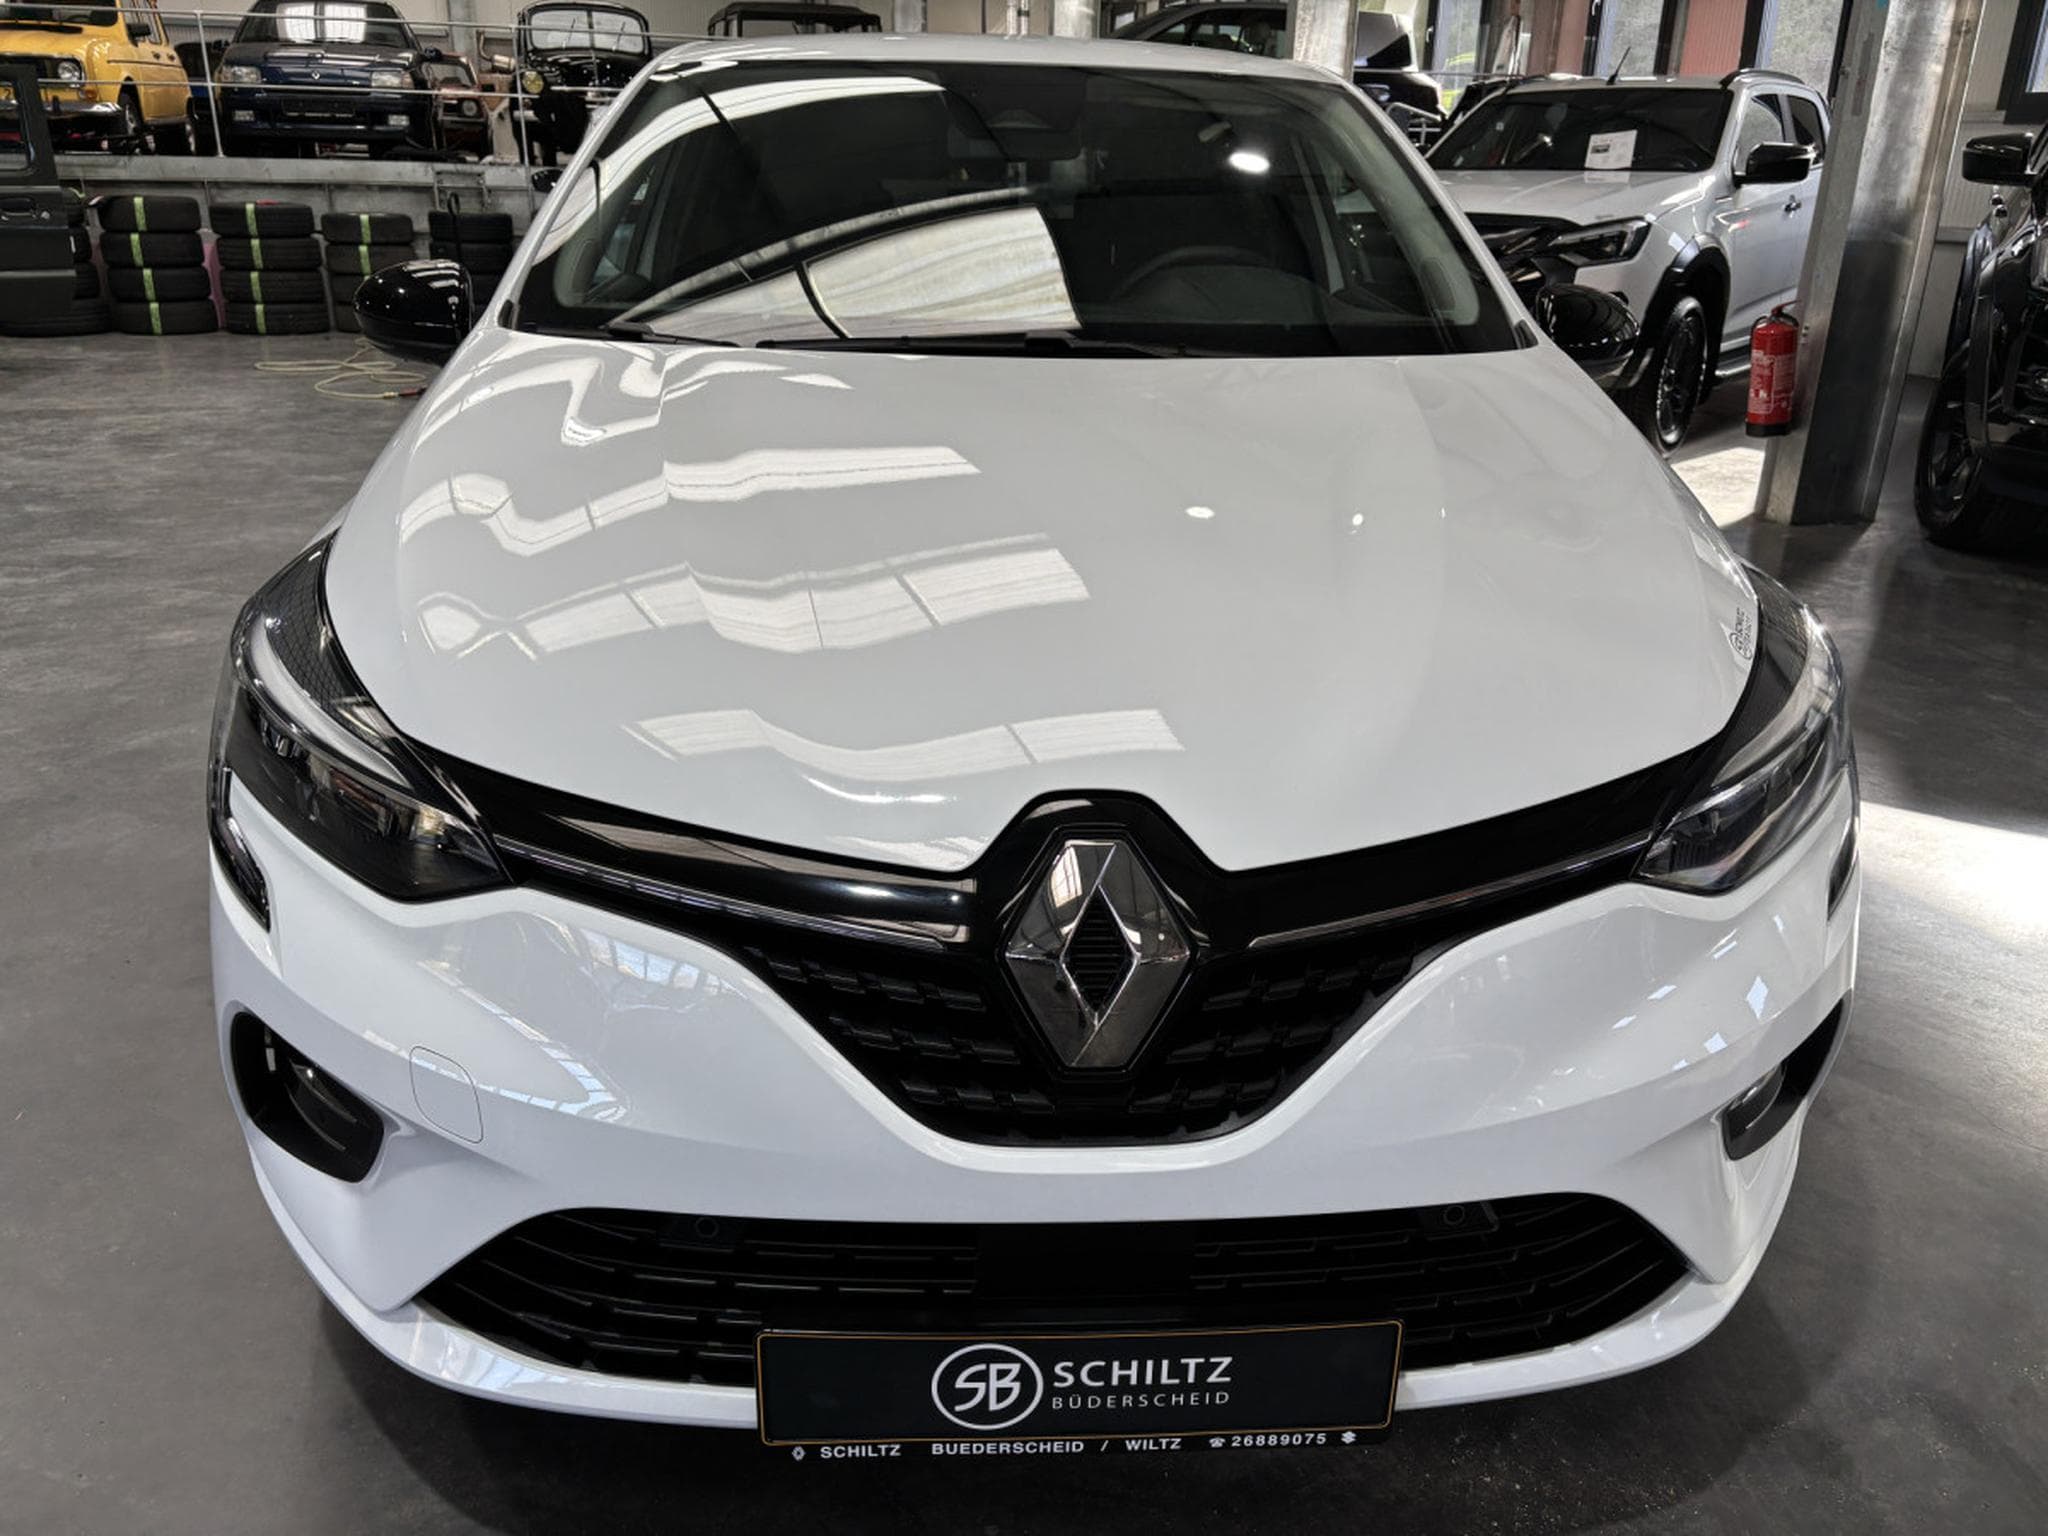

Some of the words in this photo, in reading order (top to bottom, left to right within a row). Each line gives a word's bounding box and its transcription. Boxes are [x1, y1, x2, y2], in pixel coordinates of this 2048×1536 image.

[1053, 1357, 1233, 1388] SCHILTZ
[1052, 1391, 1230, 1410] BÜDERSCHEID
[820, 1444, 901, 1459] SCHILTZ
[931, 1440, 1085, 1456] BUEDERSCHEID
[1125, 1437, 1182, 1451] WILTZ
[1231, 1432, 1327, 1447] 26889075
